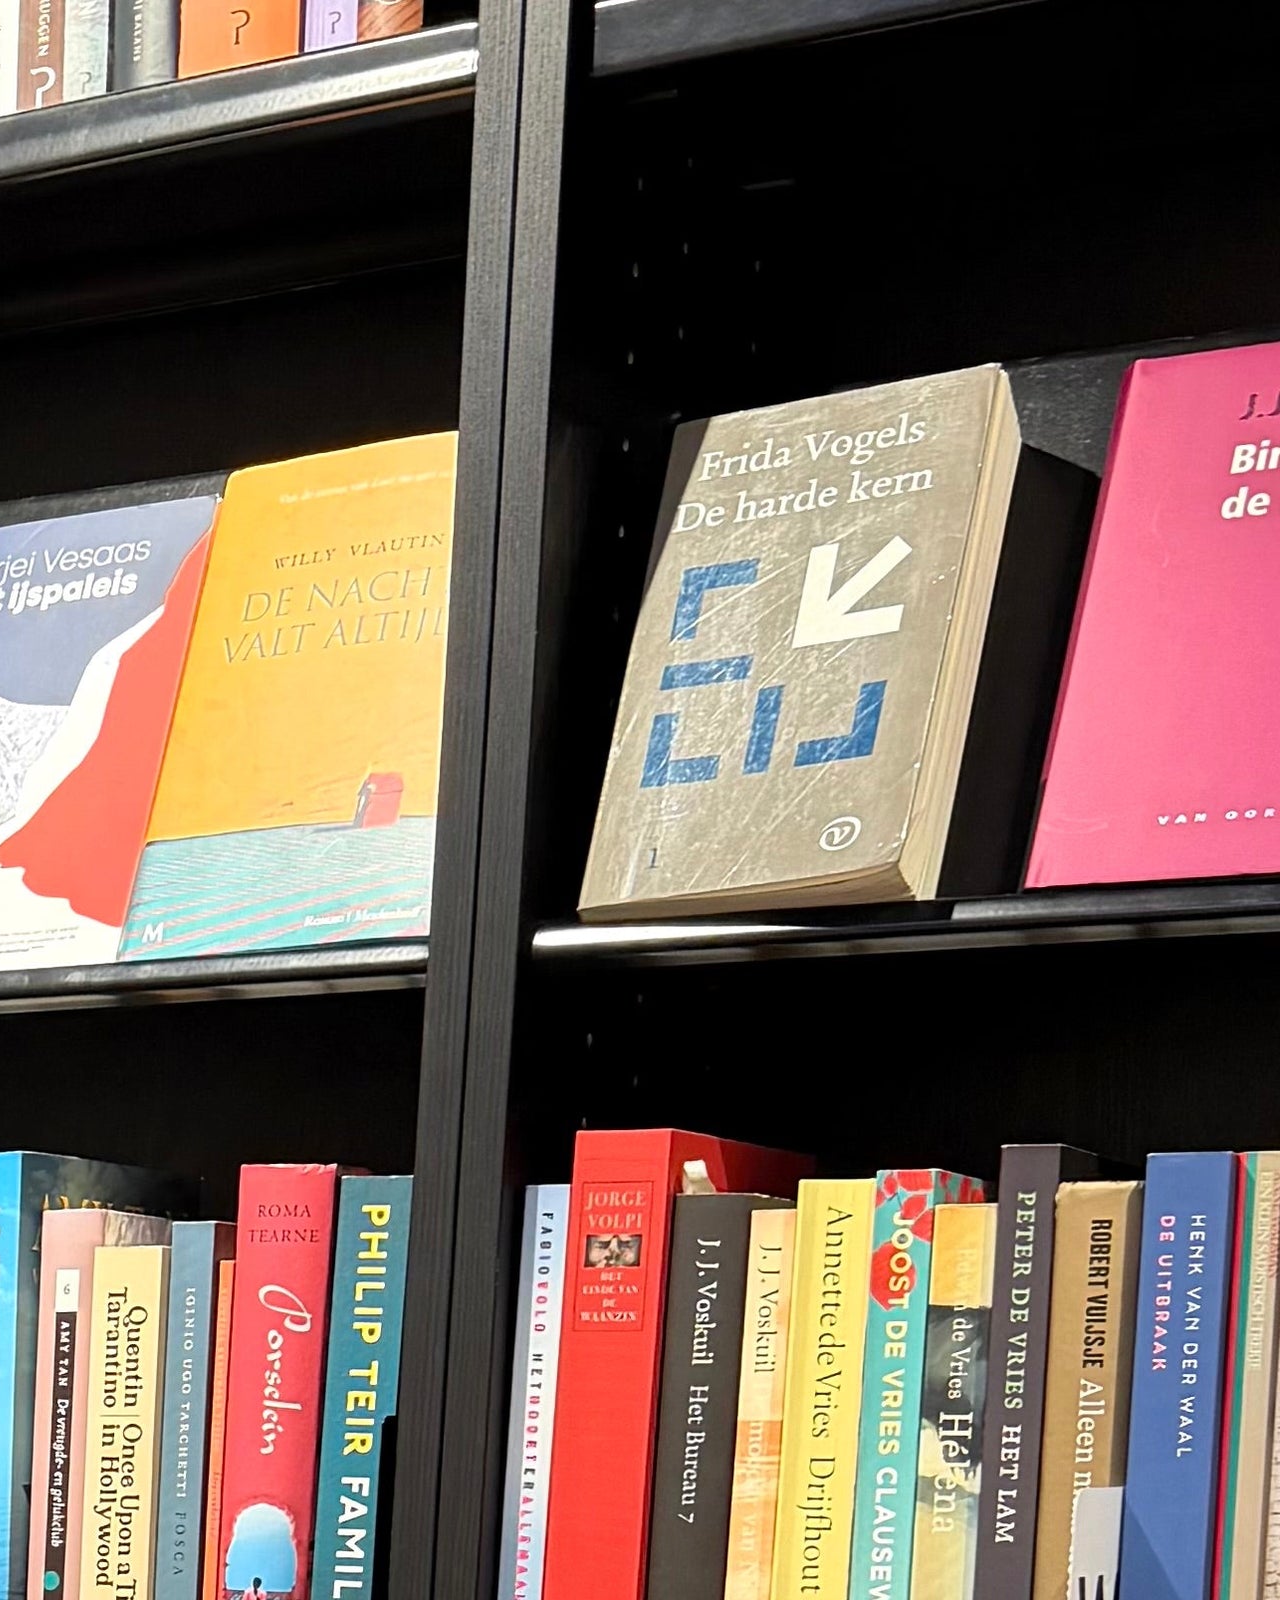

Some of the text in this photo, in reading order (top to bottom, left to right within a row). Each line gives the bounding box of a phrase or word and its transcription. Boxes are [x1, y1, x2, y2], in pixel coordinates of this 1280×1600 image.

[697, 413, 926, 484] Frida Vogels
[673, 465, 933, 534] De harde kern
[42, 538, 151, 574] Vesaas
[274, 533, 445, 570] WILLY VLAUTIN
[6, 572, 138, 615] ijspaleis
[249, 1228, 319, 1243] TEARNE
[256, 1204, 312, 1219] ROMA
[354, 1204, 391, 1344] PHILIP
[887, 1211, 913, 1312] JOOST
[1151, 1214, 1176, 1373] DE UITBRAAK
[122, 1306, 149, 1409] Quentin
[257, 1283, 312, 1457] Porselein
[886, 1320, 909, 1359] DE
[994, 1191, 1036, 1544] PETER DE VRIES HET LAM
[1175, 1214, 1207, 1458] HENK VAN DER WAAL
[94, 1287, 128, 1589] Tarantino in Hollywood
[342, 1362, 380, 1457] TEIR
[799, 1206, 853, 1595] Annette de Vries Drijfhout
[878, 1369, 905, 1455] VRIES
[119, 1423, 143, 1488] Once
[117, 1496, 141, 1550] Upon
[116, 1557, 130, 1571] a
